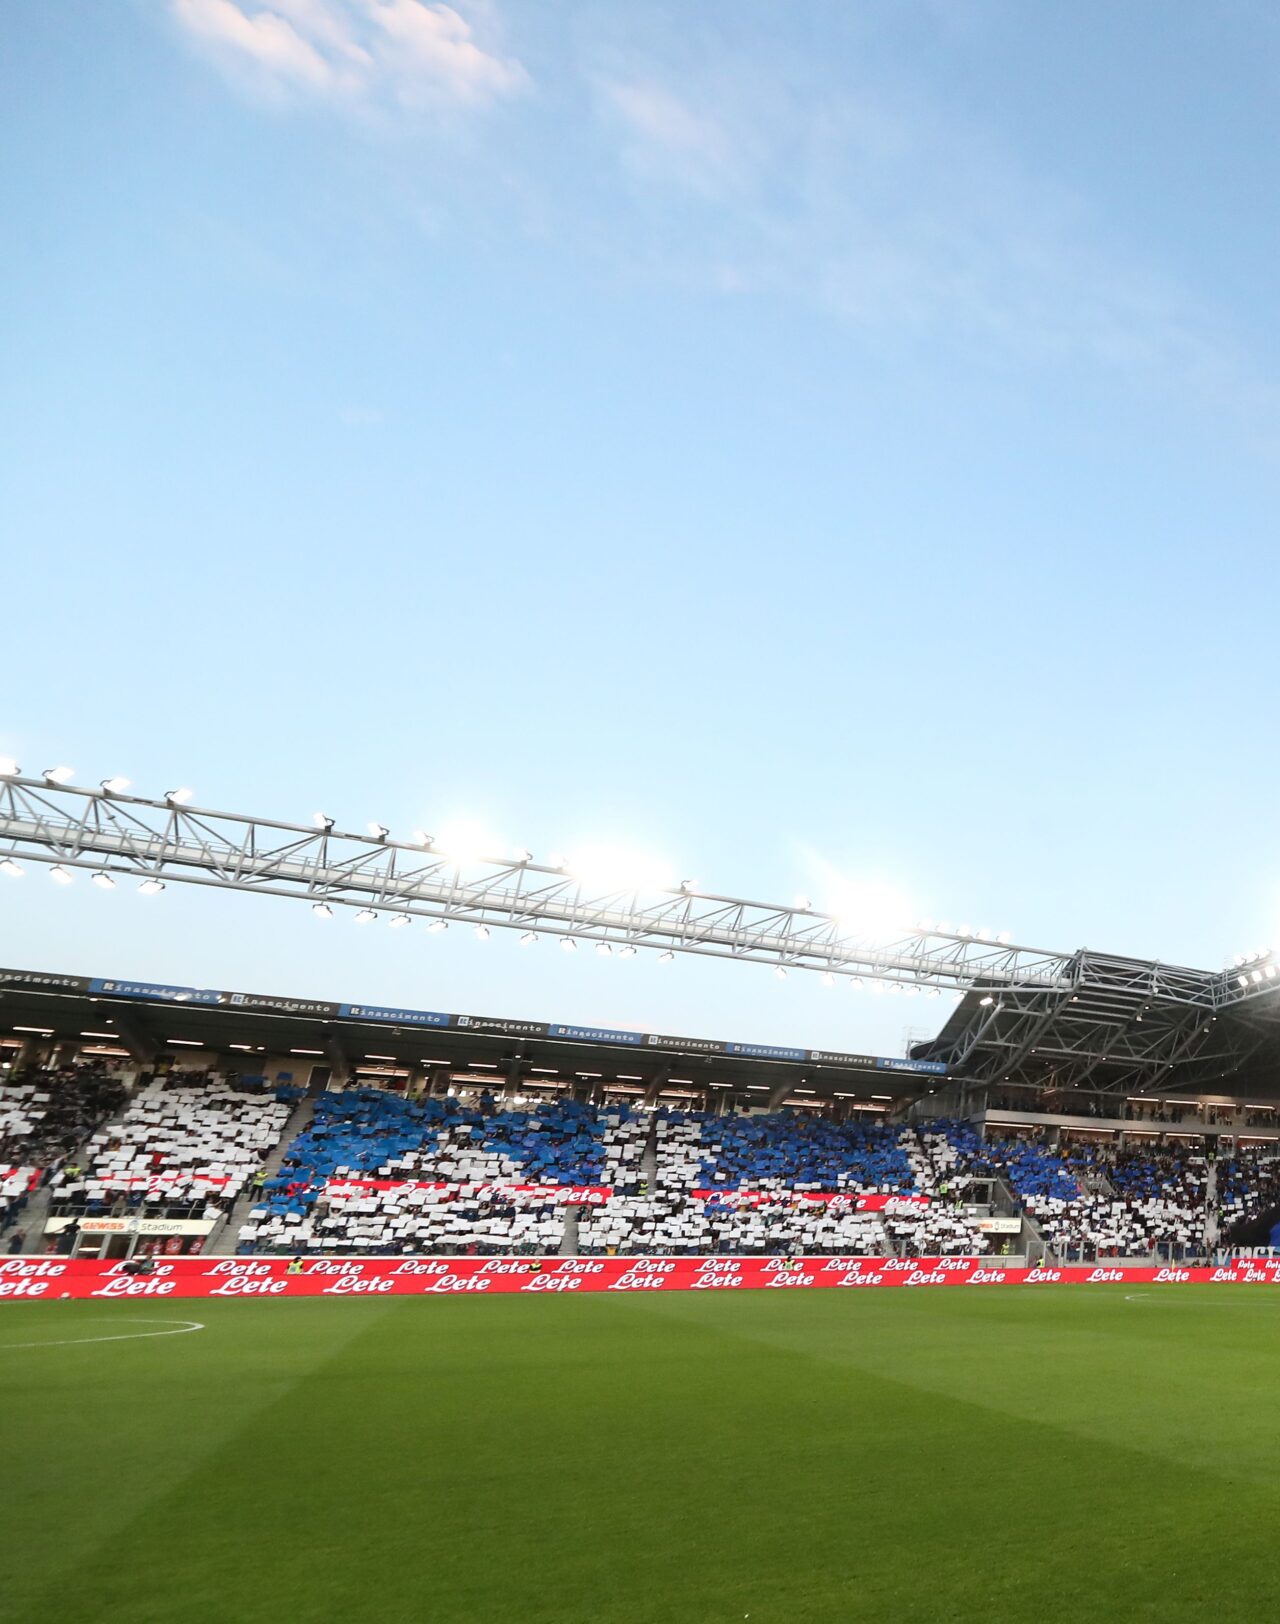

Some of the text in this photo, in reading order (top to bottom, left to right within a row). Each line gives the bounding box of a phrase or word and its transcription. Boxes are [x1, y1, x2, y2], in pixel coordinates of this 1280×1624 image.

[350, 1007, 441, 1023] Rinascimento
[457, 1016, 542, 1032] Rinascimento
[648, 1035, 720, 1050] Rinascimento
[82, 1222, 183, 1231] GEWISS Stadium
[0, 1259, 66, 1276] Lete
[100, 1260, 174, 1276] Lte
[202, 1260, 272, 1276] Lete
[303, 1259, 364, 1275] Lete
[389, 1259, 450, 1275] Lete
[474, 1259, 531, 1275] Lete
[552, 1259, 605, 1274] Lete
[626, 1259, 676, 1273] Lete
[695, 1258, 741, 1273] Lete
[820, 1258, 862, 1272] Lete
[878, 1258, 919, 1271] Lete
[932, 1258, 971, 1271] Lete
[425, 1273, 491, 1292] Lete
[521, 1273, 582, 1292] Lete
[608, 1273, 665, 1290] Lete
[690, 1272, 743, 1288] Lete
[765, 1271, 815, 1287] Lete
[837, 1271, 883, 1286] Lete
[902, 1270, 946, 1285] Lete
[965, 1269, 1006, 1283] Lete
[1023, 1268, 1061, 1283] Lete
[1086, 1268, 1124, 1282] Lete
[1153, 1268, 1190, 1282] Lete
[1210, 1268, 1238, 1281] Lete
[1242, 1268, 1266, 1282] Lete
[0, 1276, 49, 1296] ete
[91, 1275, 177, 1296] Lete
[209, 1275, 288, 1295] Lete
[322, 1274, 395, 1294] Lete
